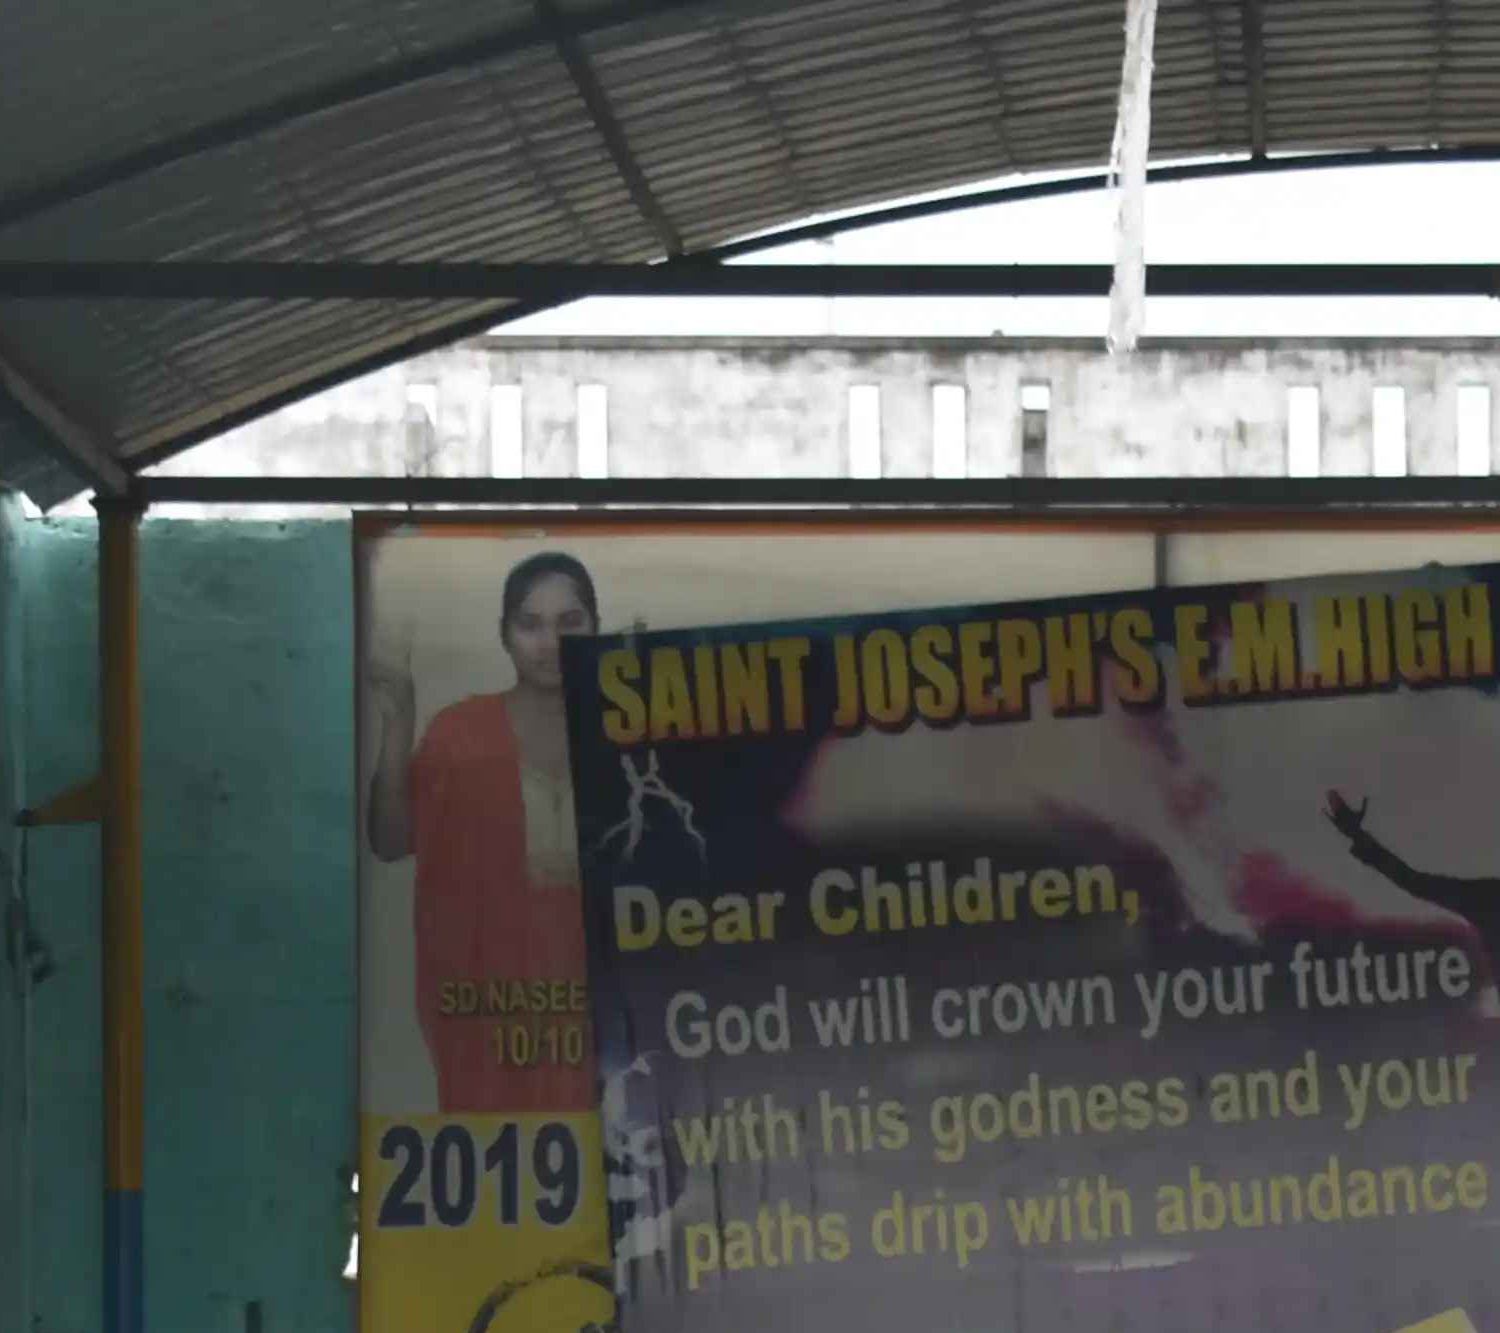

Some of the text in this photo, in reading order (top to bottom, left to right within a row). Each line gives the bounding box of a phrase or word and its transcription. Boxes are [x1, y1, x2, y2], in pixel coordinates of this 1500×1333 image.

[595, 636, 813, 746] SAINT
[832, 607, 1164, 734] JOSEPH'S
[612, 858, 1141, 952] Dear Children,
[495, 1024, 584, 1066] 10/10
[664, 940, 1472, 1061] God will crown your future
[672, 1048, 1477, 1172] with his godness and your
[377, 1121, 582, 1230] 2019
[684, 1155, 1491, 1289] paths drip with abundance
